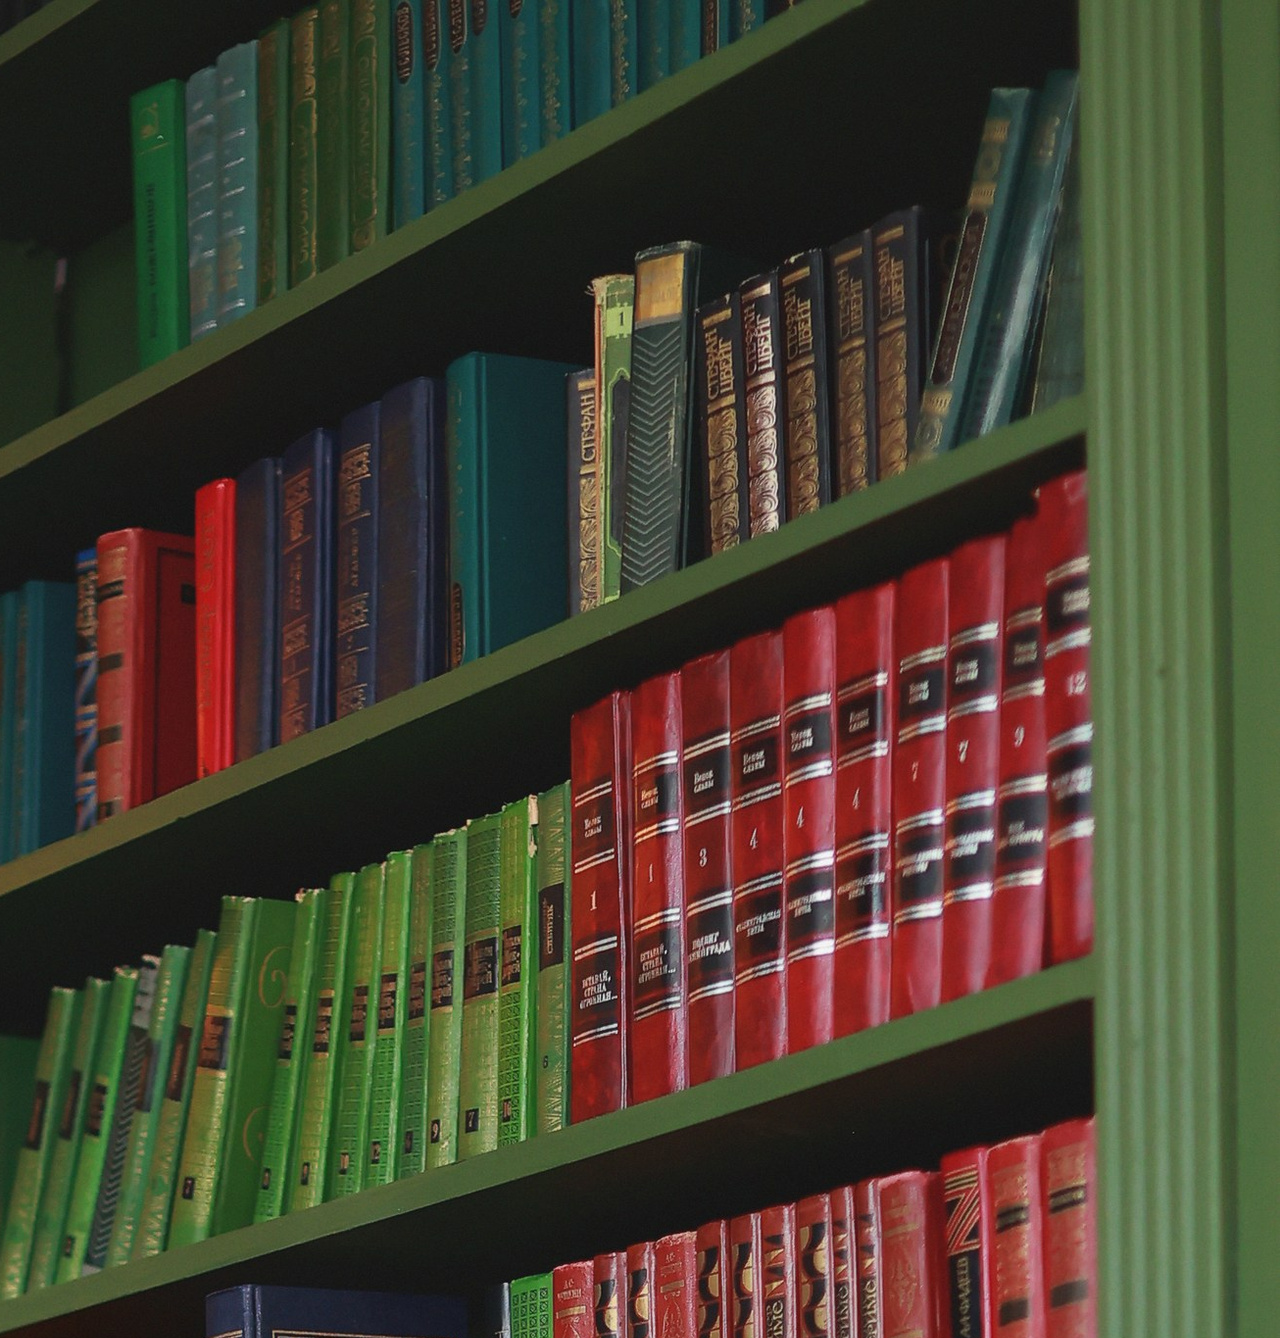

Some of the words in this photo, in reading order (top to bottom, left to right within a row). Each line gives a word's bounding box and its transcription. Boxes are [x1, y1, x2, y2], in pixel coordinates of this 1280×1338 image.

[837, 266, 850, 339] СТЕФАН
[878, 247, 891, 321] СТЕФАН
[743, 304, 757, 376] СТЕФАН
[784, 287, 798, 360] СТЕФАН
[705, 328, 719, 400] СТЕФАН
[580, 393, 595, 462] СТЕФАН
[749, 828, 758, 850] 4
[796, 806, 804, 828] 4
[699, 848, 707, 868] 3
[590, 890, 597, 911] 1
